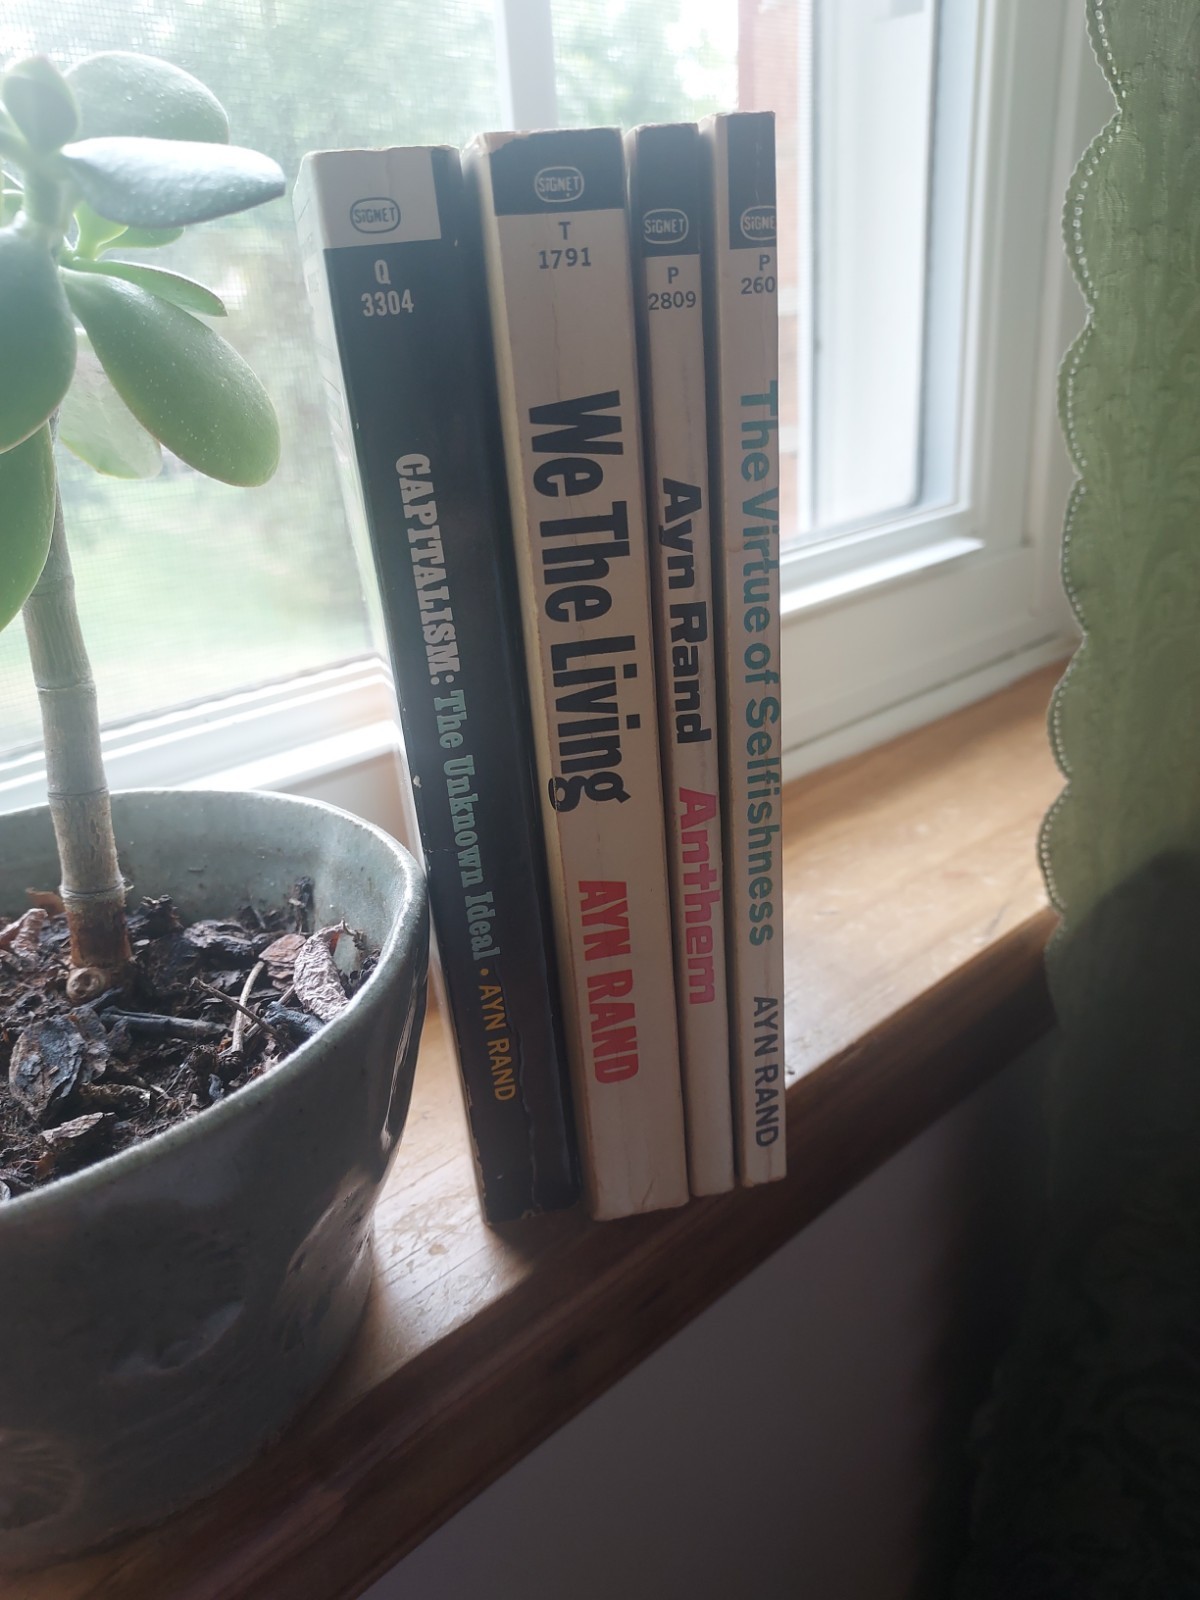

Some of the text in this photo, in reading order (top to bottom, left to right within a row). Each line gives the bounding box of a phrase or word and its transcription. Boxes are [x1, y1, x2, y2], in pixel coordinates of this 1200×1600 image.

[558, 221, 572, 241] T
[374, 259, 391, 285] Q
[538, 247, 592, 270] 1791
[759, 255, 771, 271] P
[667, 266, 680, 284] P
[741, 276, 776, 295] 260
[361, 289, 415, 317] 3304
[648, 291, 697, 311] 2809
[528, 390, 641, 813] We The Living
[659, 477, 712, 744] Ayn Rand
[740, 380, 780, 946] The Virtue of Selfishness
[395, 453, 517, 1101] CAPITALISM: The Unknown Ideal AYN RAND
[679, 786, 721, 1006] Anthem
[578, 880, 639, 1084] AYN RAND
[753, 996, 780, 1148] AYN RAND
